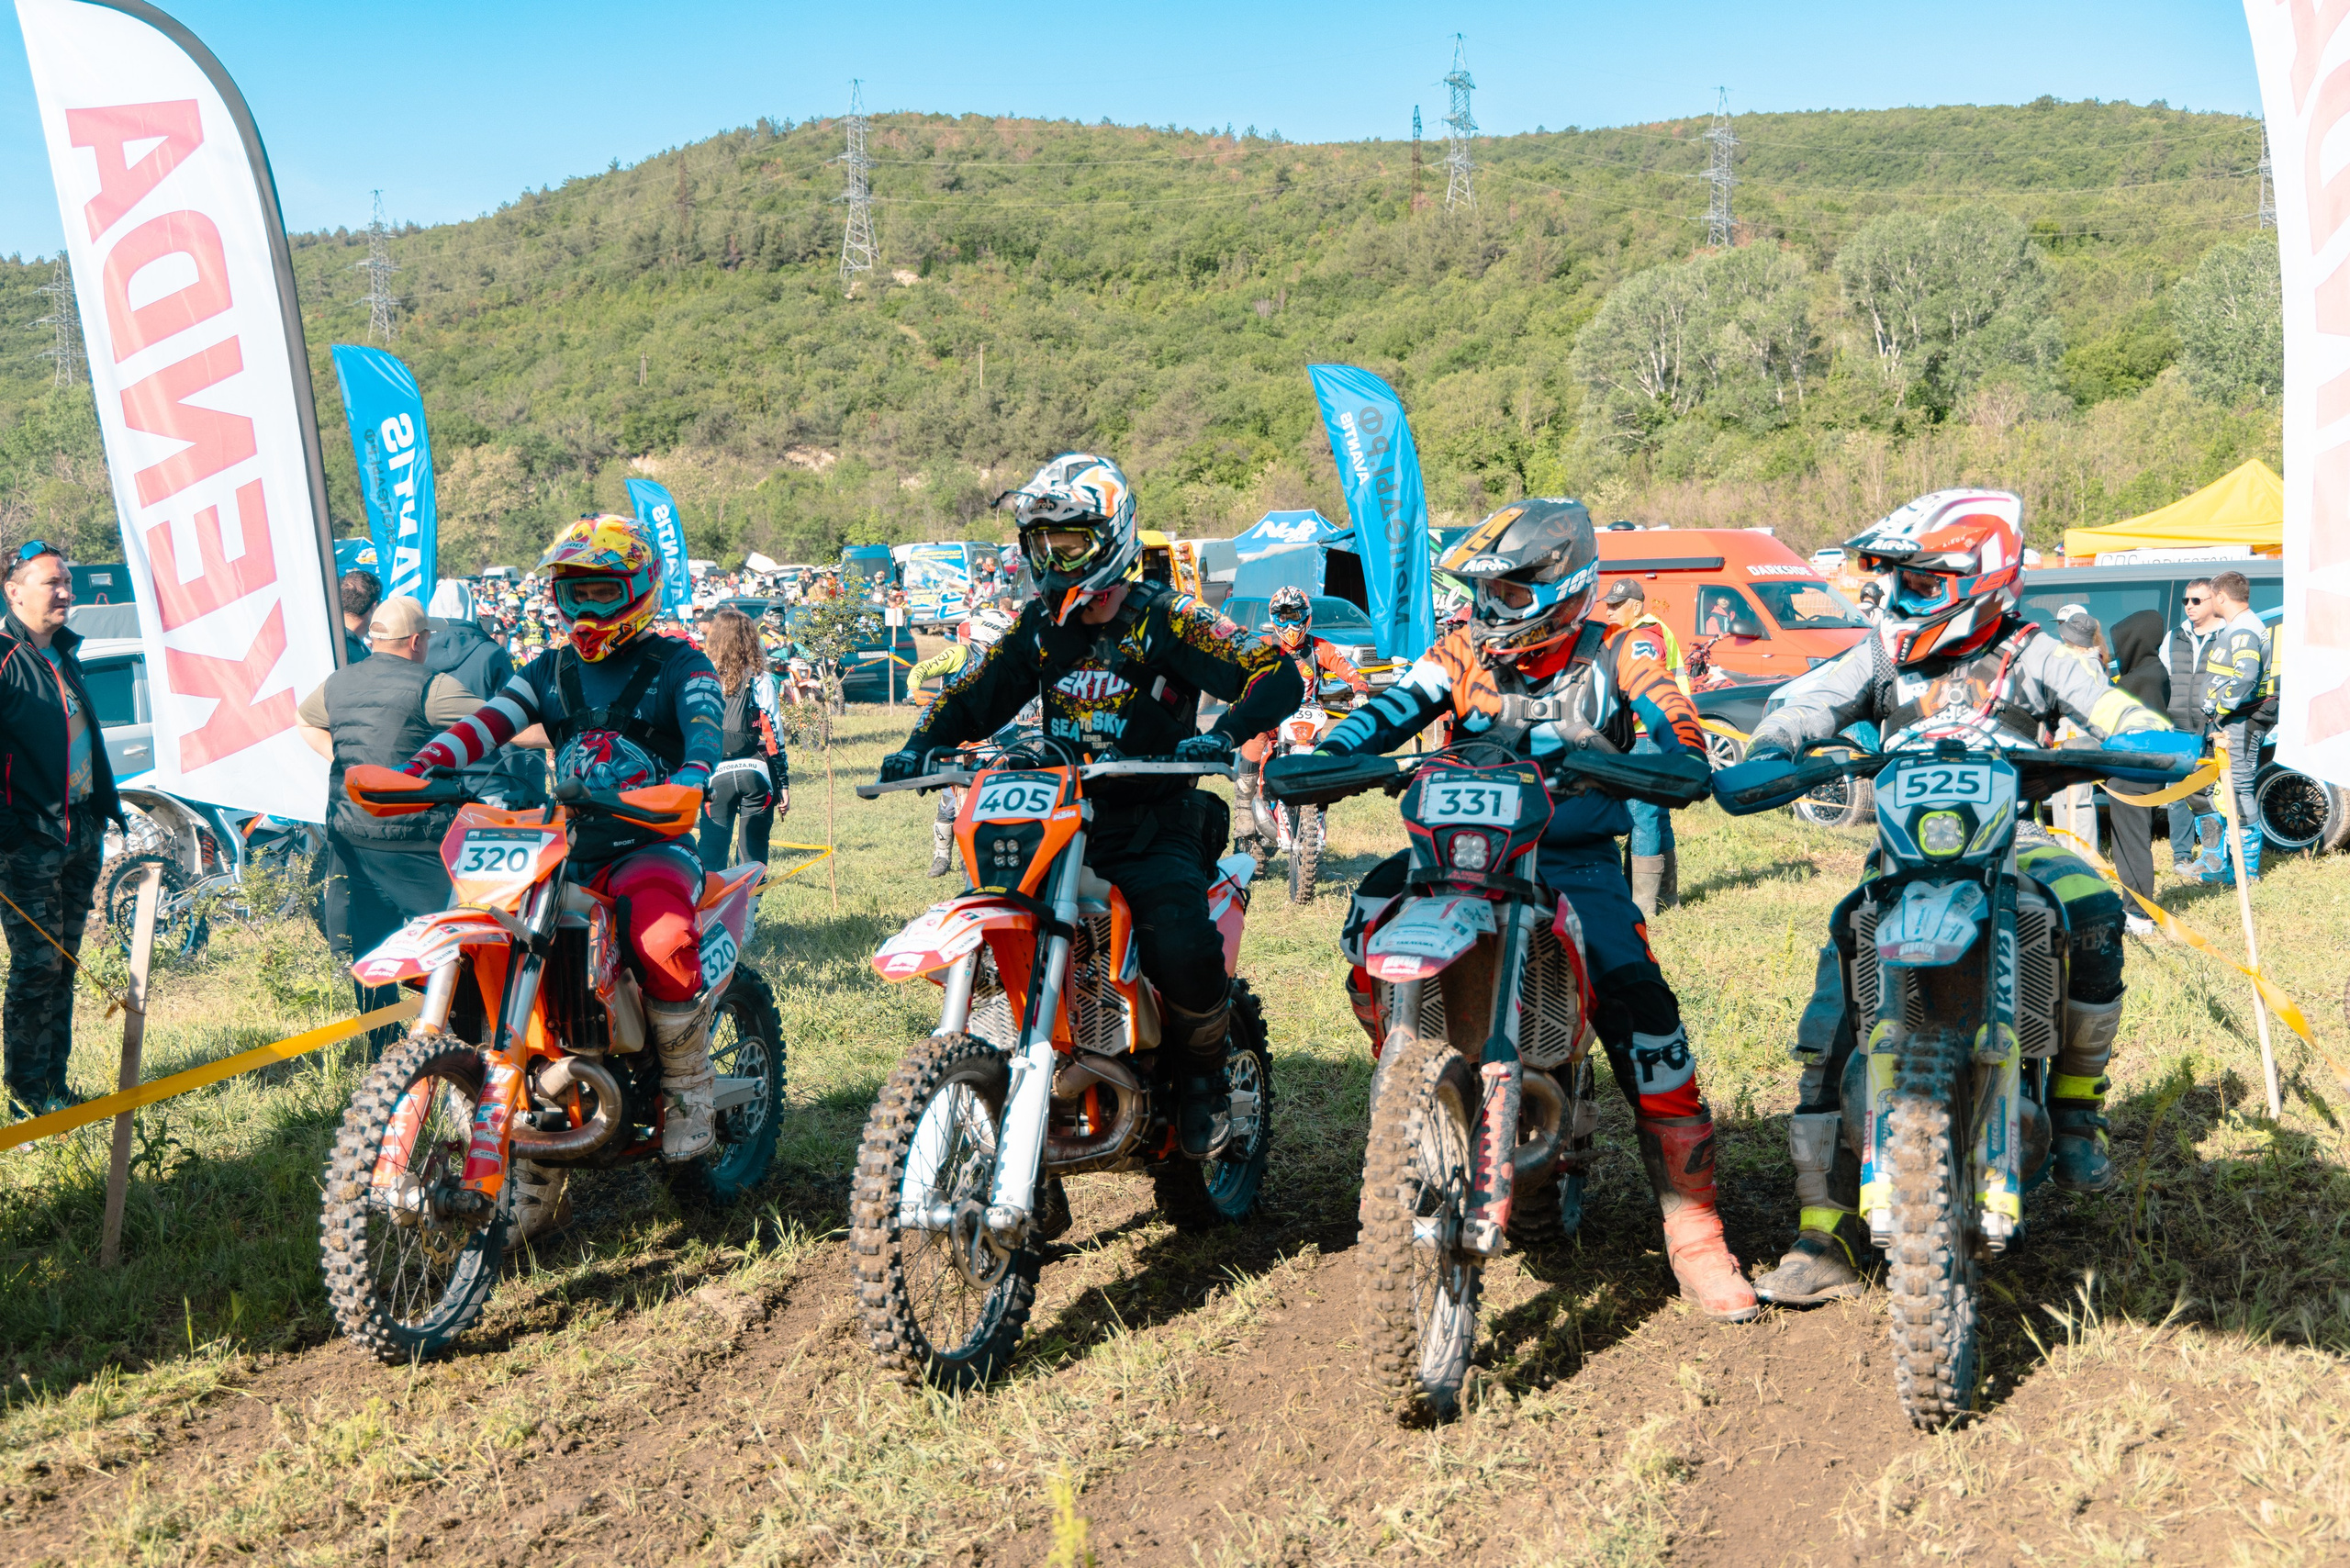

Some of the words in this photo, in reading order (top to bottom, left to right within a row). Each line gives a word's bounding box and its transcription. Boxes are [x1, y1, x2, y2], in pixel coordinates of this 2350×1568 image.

[1866, 538, 1918, 551] Airoh
[1461, 558, 1509, 571] Airoh
[1745, 566, 1813, 577] DARKSIDE
[1051, 717, 1080, 743] SEA
[1078, 716, 1092, 733] TO
[1091, 710, 1128, 739] SKY
[1904, 770, 1980, 798] 525
[979, 787, 1051, 812] 405
[1438, 789, 1503, 817] 331
[613, 838, 635, 846] SPORT
[463, 846, 530, 873] 320
[702, 939, 736, 981] 320
